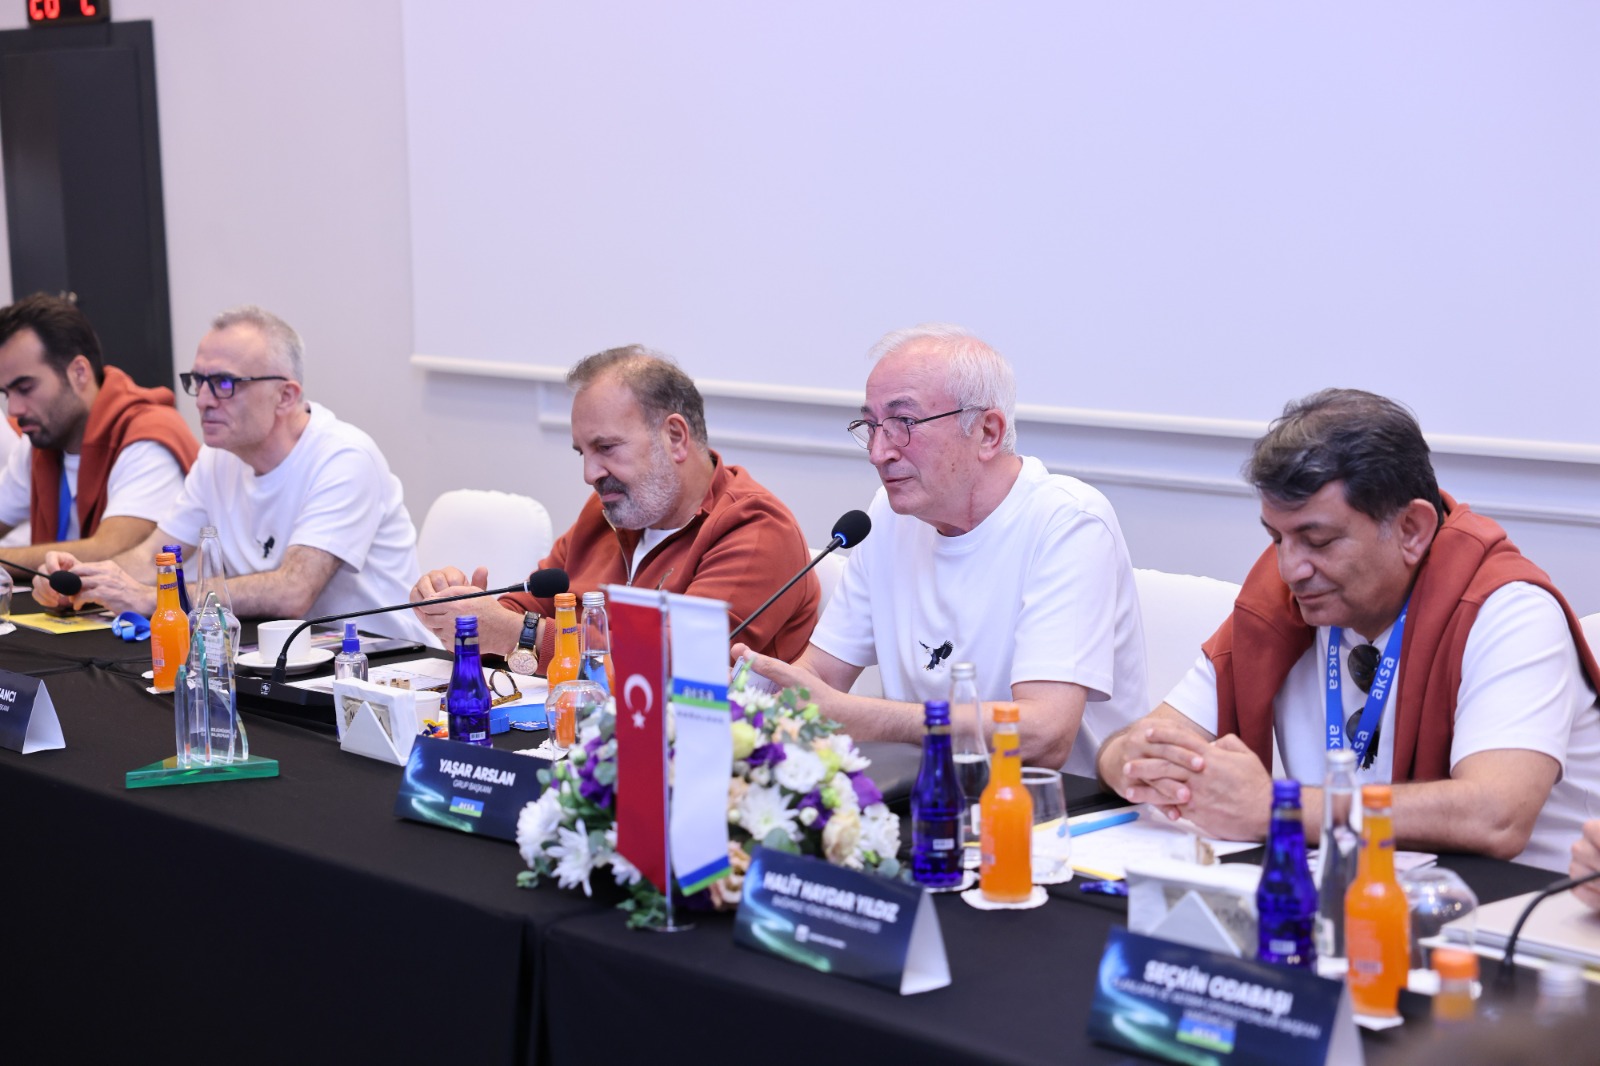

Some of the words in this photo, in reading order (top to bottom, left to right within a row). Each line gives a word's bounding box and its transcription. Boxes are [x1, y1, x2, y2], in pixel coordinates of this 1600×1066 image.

[1328, 645, 1339, 690] aksa
[1371, 656, 1395, 700] aksa
[1329, 724, 1341, 754] ak
[439, 758, 473, 779] YAŞAR
[472, 766, 516, 787] ARSLAN
